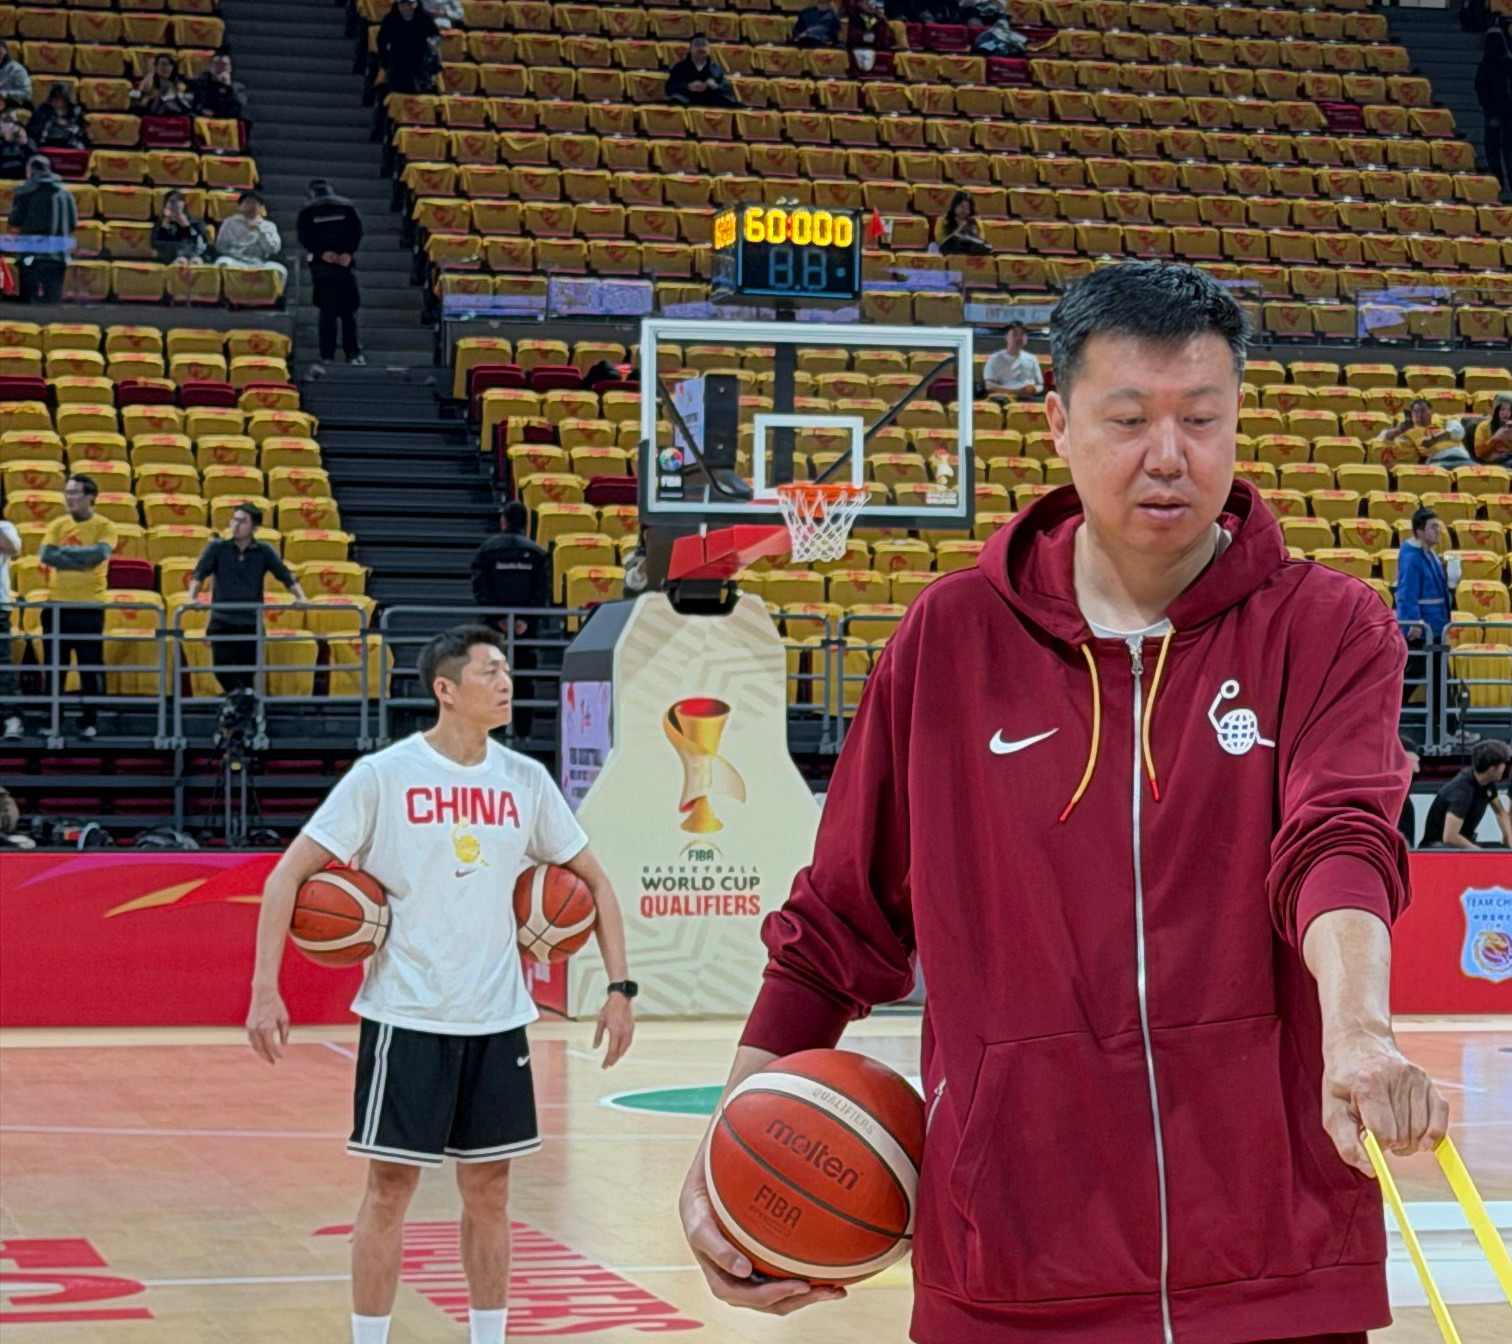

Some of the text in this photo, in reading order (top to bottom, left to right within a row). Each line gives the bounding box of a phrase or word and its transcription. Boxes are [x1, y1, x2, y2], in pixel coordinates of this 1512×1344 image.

[406, 786, 521, 829] CHINA
[688, 849, 714, 862] FIBA
[641, 876, 761, 892] WORLD CUP
[640, 895, 761, 919] QUALIFIERS
[811, 1087, 877, 1136] QUALIFIERS
[765, 1118, 861, 1192] molten
[753, 1184, 802, 1229] FIBA
